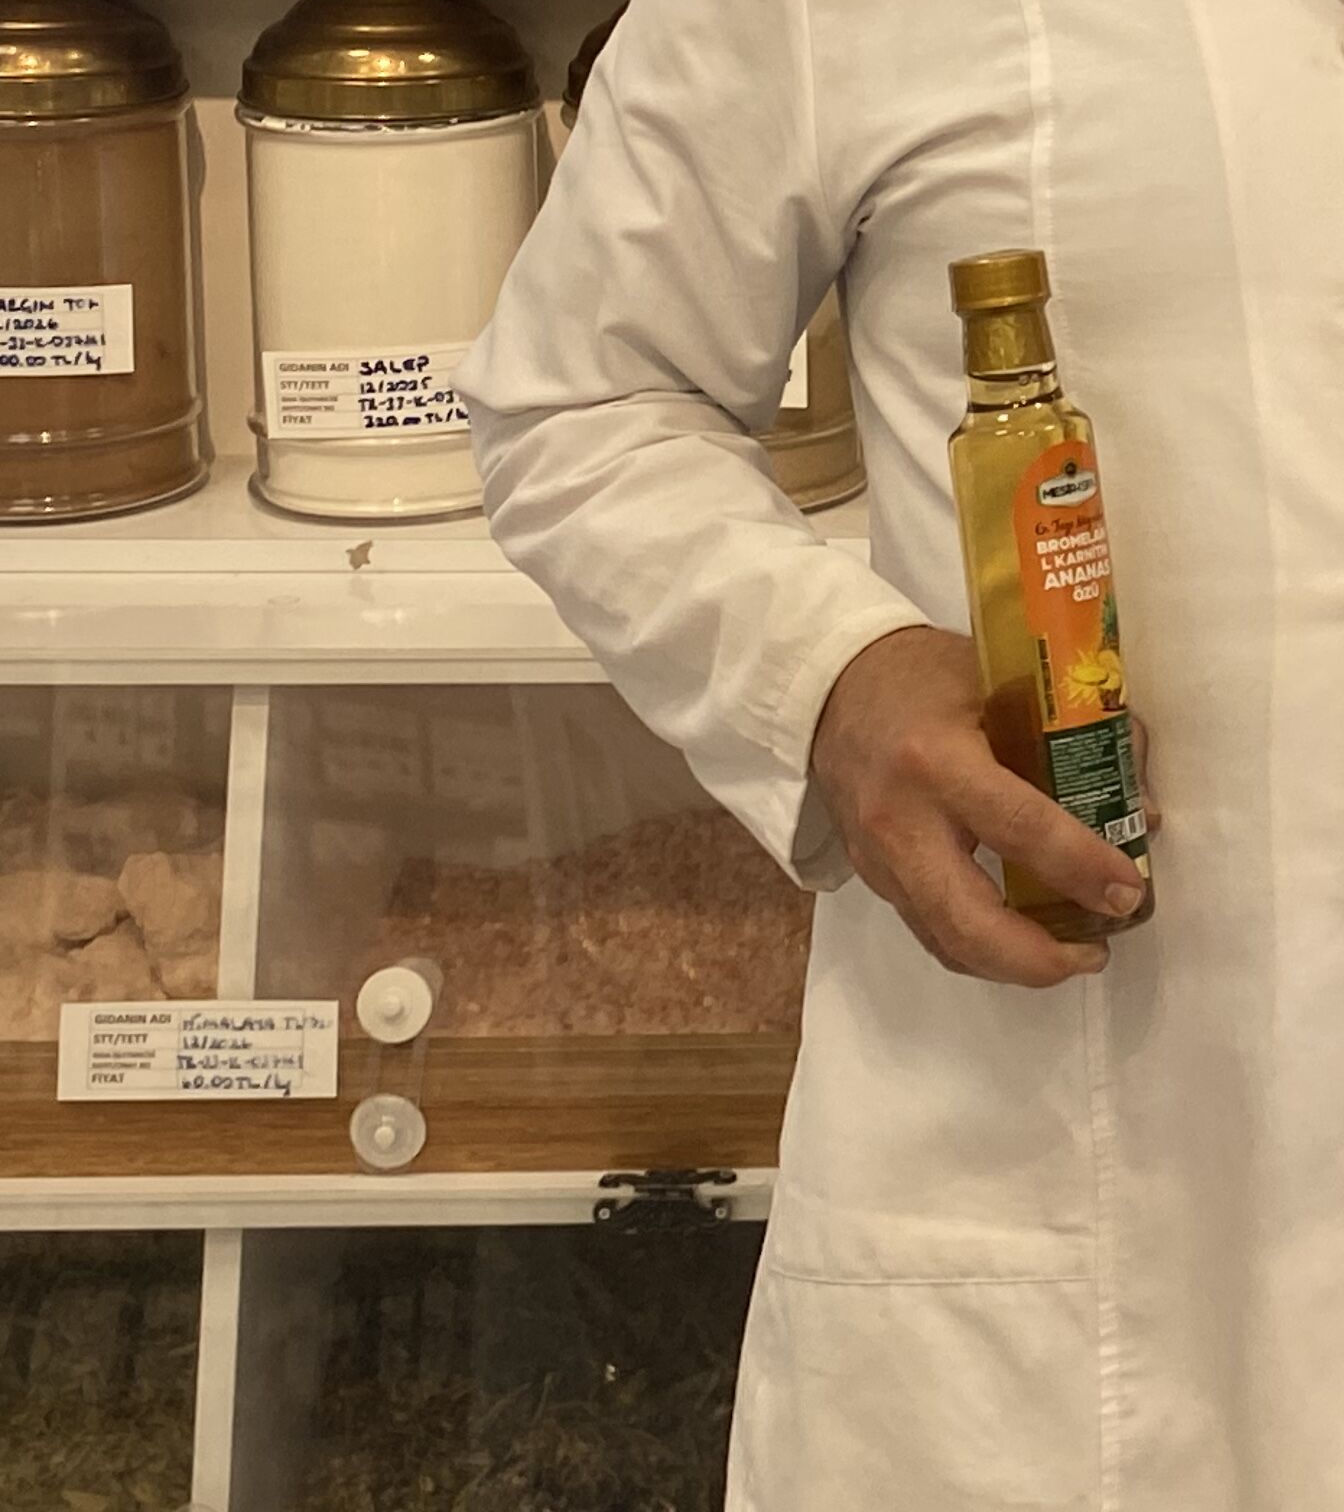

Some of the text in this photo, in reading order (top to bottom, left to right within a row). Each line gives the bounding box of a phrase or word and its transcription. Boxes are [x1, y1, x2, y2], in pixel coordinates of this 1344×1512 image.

[1044, 558, 1111, 590] ANANAS
[94, 1014, 147, 1024] GIDANIN
[149, 1014, 171, 1024] ADI
